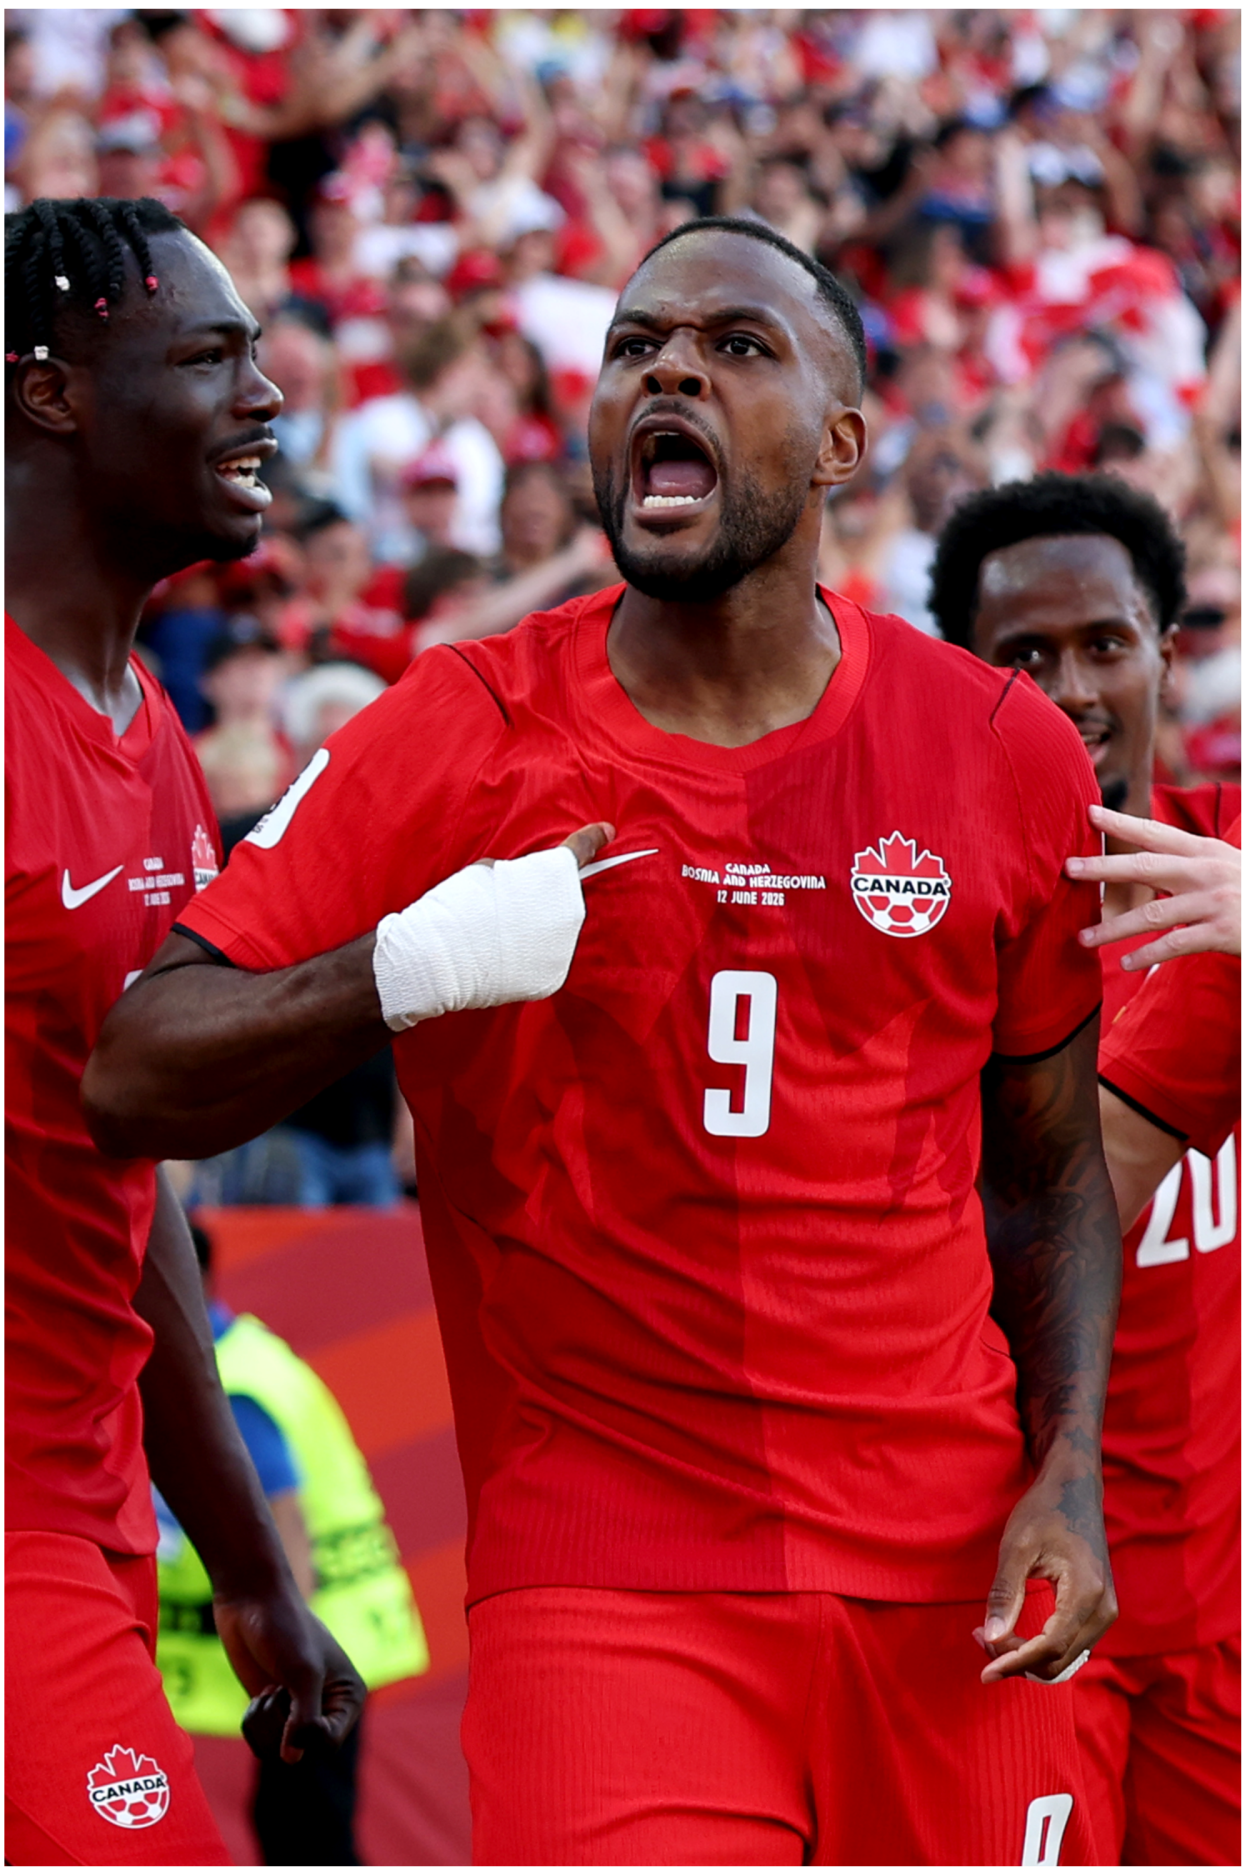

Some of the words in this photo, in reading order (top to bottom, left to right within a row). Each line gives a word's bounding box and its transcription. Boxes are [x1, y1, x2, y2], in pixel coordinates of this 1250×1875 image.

[681, 864, 720, 884] BOSNIA
[723, 874, 746, 887] AND
[749, 875, 827, 889] HERZEGOVINA
[725, 863, 771, 876] CANADA
[853, 877, 947, 896] CANADA
[717, 890, 727, 903] 12
[731, 891, 757, 905] JUNE
[761, 892, 785, 906] 2026
[703, 970, 777, 1137] 9
[92, 1776, 166, 1803] CANADA
